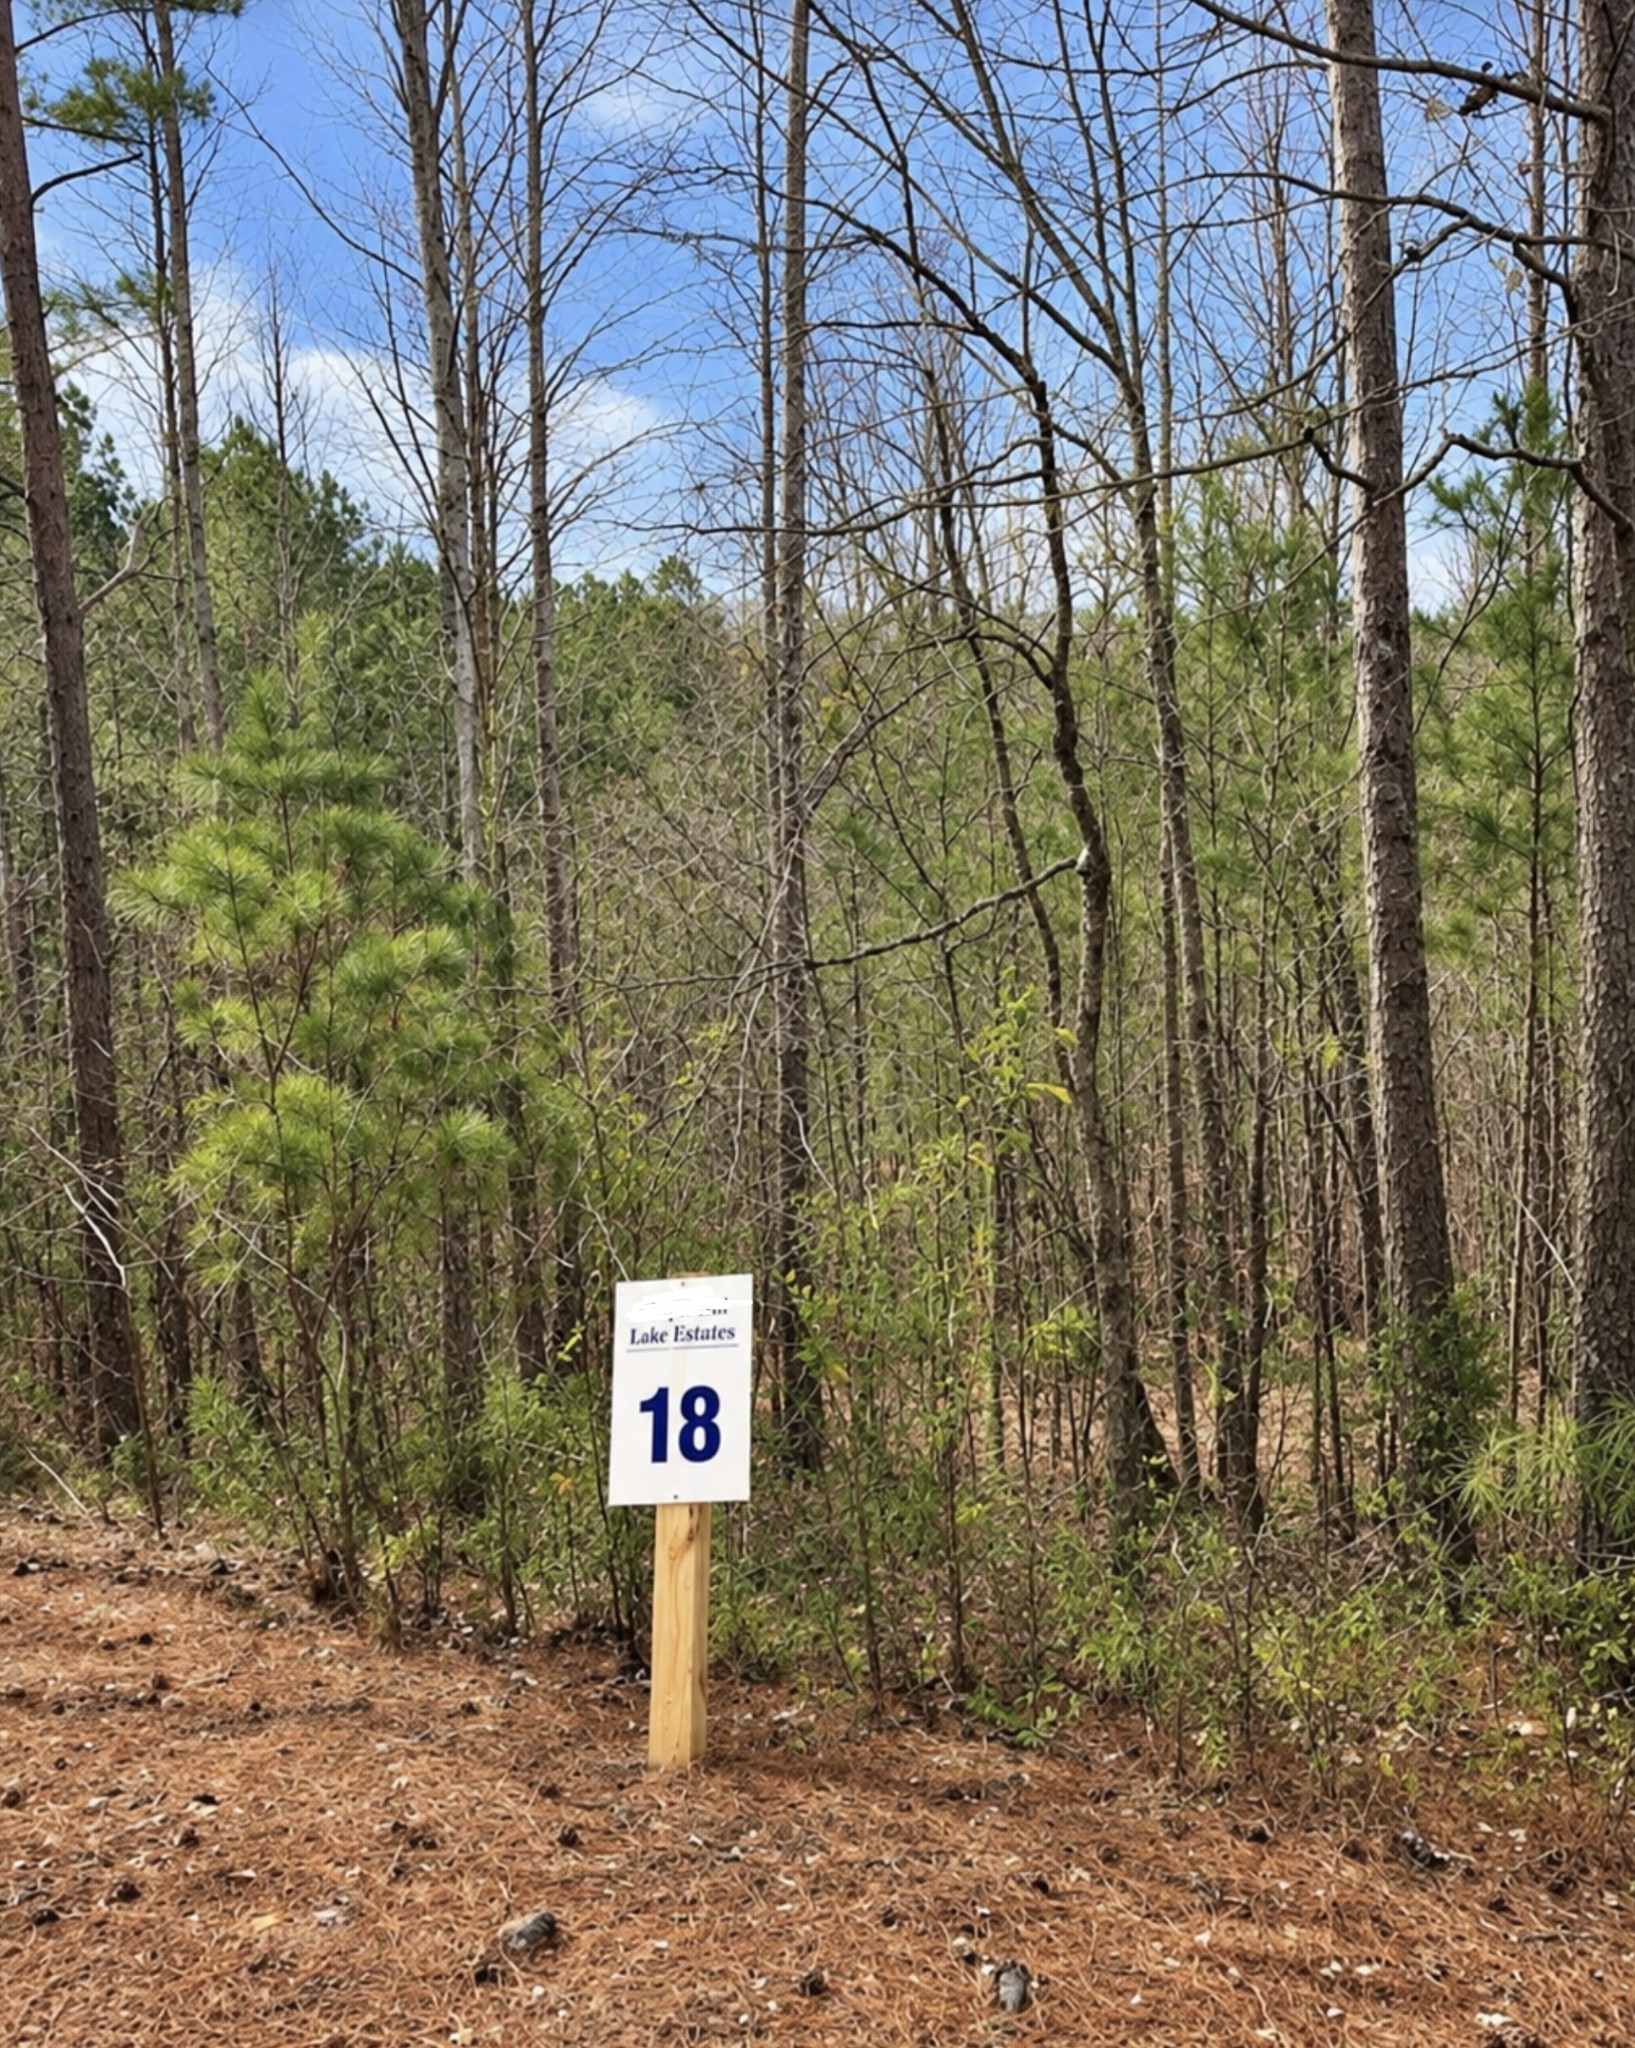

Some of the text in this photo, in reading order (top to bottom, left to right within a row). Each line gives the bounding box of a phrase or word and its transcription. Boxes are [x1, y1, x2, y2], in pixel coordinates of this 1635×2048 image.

[630, 1324, 736, 1345] Lake Estates
[639, 1385, 721, 1464] 18
